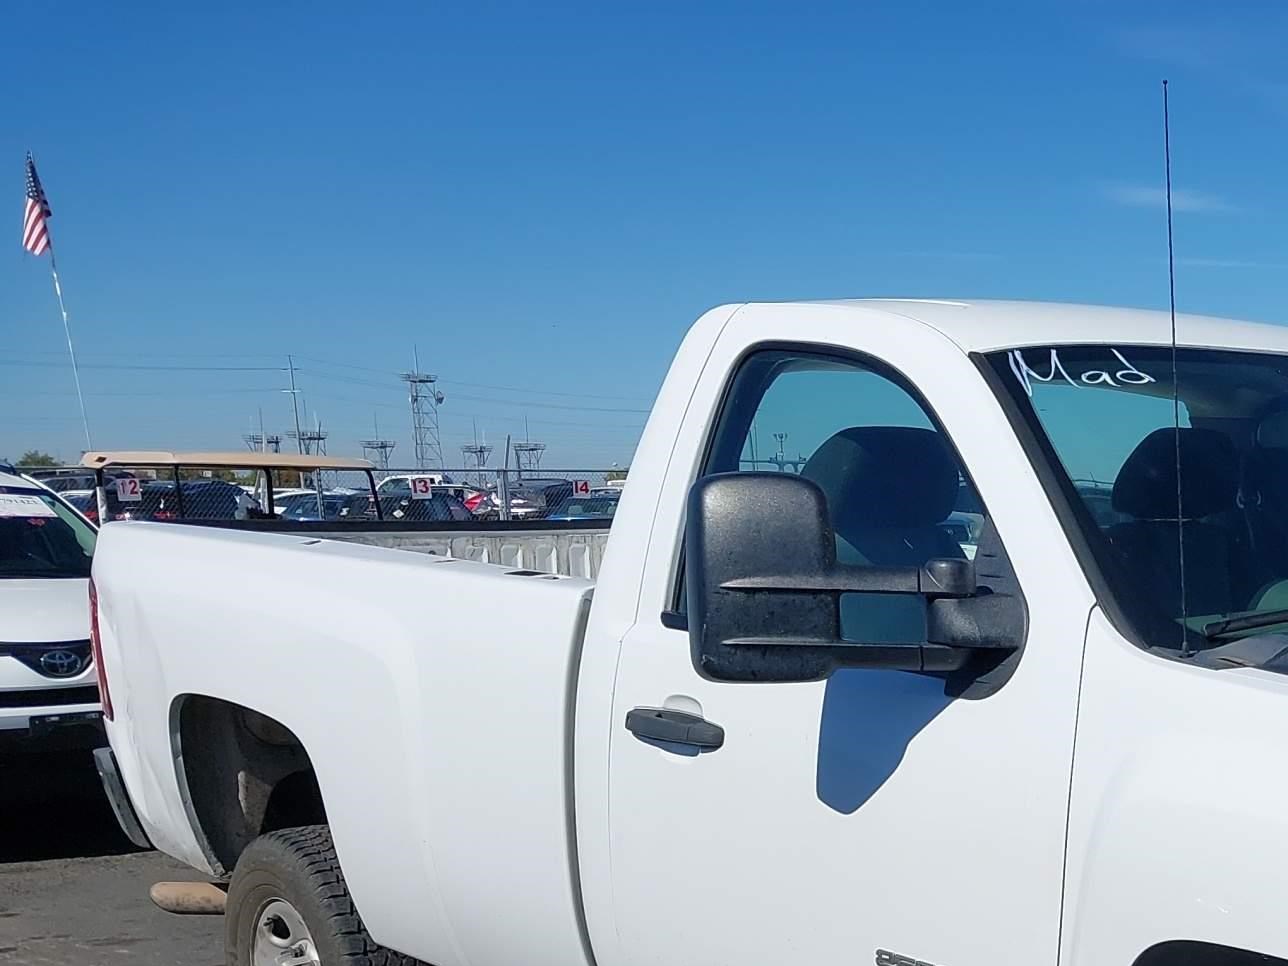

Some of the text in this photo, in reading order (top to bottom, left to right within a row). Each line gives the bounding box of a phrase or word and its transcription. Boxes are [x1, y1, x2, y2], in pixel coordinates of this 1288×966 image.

[1007, 348, 1157, 397] Mad
[120, 479, 139, 495] 12
[412, 479, 430, 494] 13
[574, 480, 590, 494] 14
